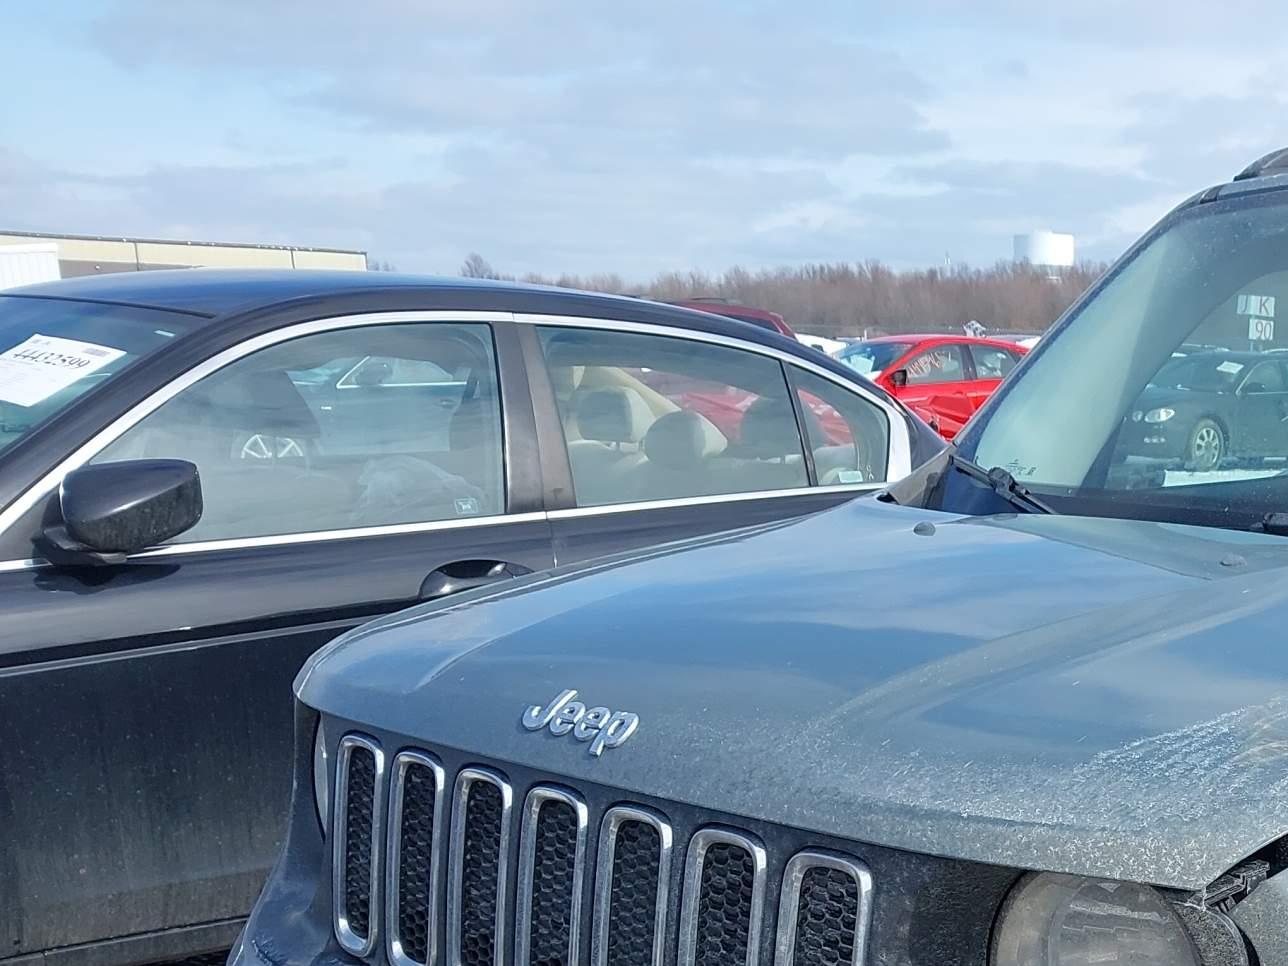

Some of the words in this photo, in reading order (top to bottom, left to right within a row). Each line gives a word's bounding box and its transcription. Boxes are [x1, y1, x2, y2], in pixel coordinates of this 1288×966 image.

[1258, 296, 1270, 316] K
[1255, 320, 1272, 340] 90
[522, 688, 640, 758] Jeep
